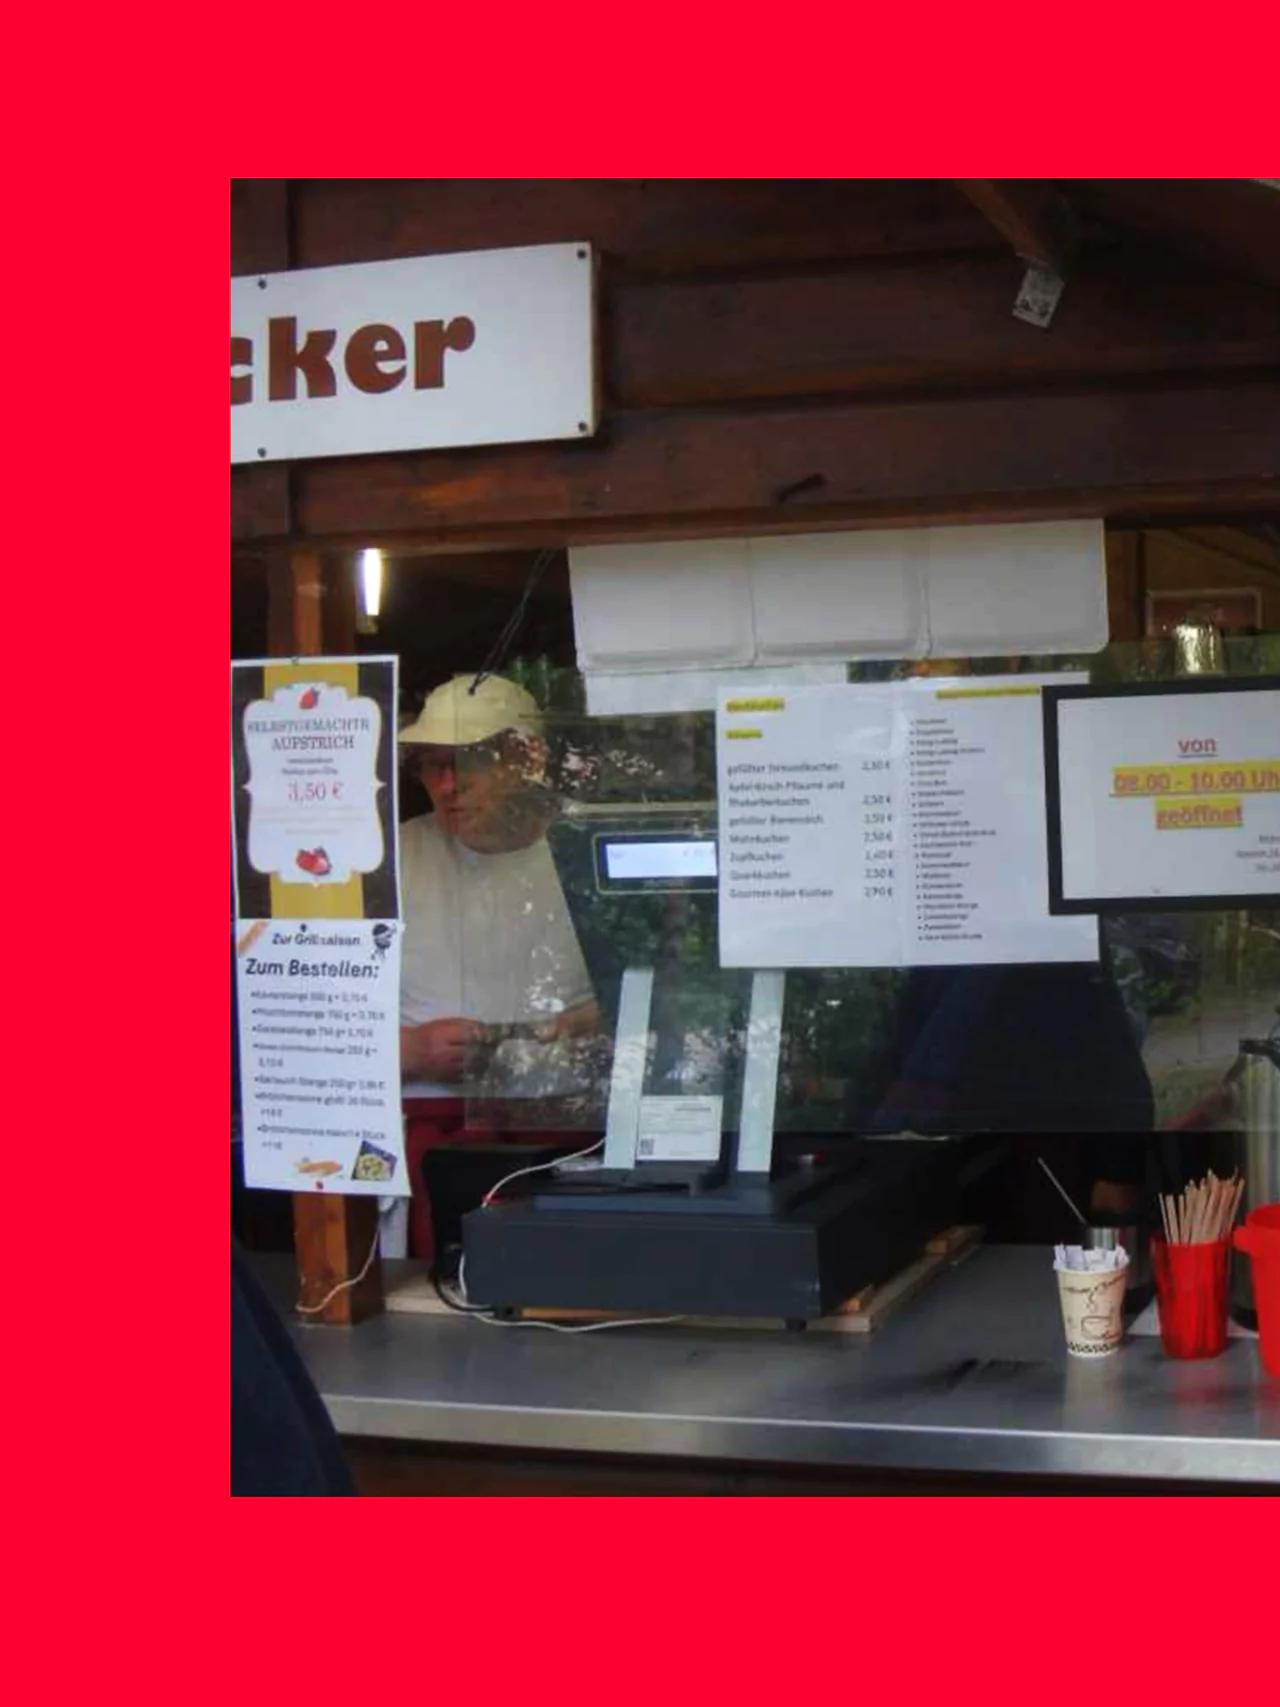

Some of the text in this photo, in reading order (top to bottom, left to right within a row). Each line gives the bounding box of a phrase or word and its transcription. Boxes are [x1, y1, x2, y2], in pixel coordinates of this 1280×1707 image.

[1177, 738, 1218, 756] von
[288, 780, 326, 802] 3,50
[1156, 803, 1245, 828] geöffnet
[245, 957, 380, 979] Zum Bestellen:
